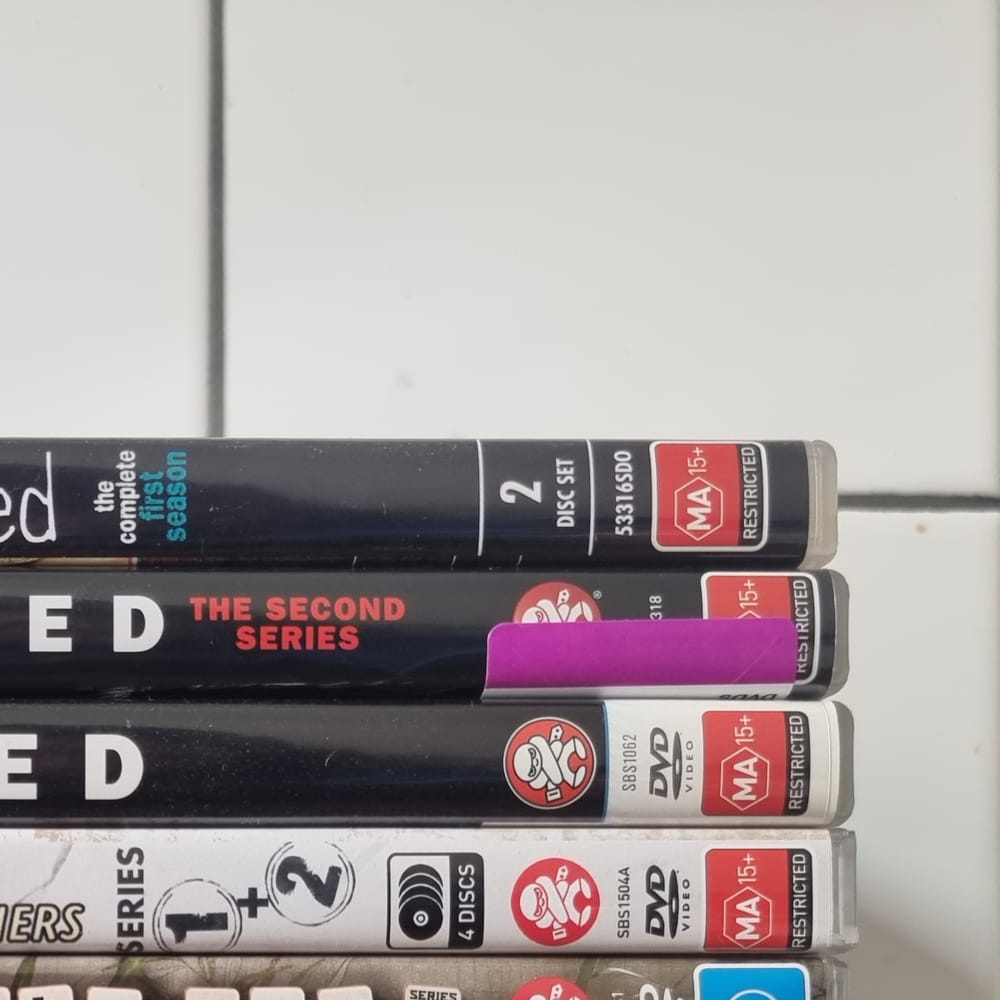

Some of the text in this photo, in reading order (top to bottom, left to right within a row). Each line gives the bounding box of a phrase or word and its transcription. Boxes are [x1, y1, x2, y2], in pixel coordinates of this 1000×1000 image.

[94, 480, 115, 513] the
[119, 450, 137, 545] complete
[140, 471, 164, 522] first
[166, 451, 188, 542] season
[500, 481, 542, 504] 2
[556, 457, 575, 528] DISC SET
[686, 446, 712, 531] MA 15+
[742, 446, 756, 541] RESTRICTED
[190, 597, 406, 622] THE SECOND
[738, 579, 759, 609] 15+
[236, 626, 360, 651] SERIES
[621, 733, 638, 793] SBS1062
[649, 727, 671, 800] DVD
[685, 740, 694, 793] VIDEO
[731, 714, 758, 802] MA 15+
[788, 714, 803, 811] RESTRICTED
[115, 846, 145, 953] SERIES
[457, 863, 476, 941] 4 DISCS
[617, 866, 631, 940] SBS1504A
[645, 864, 667, 939] DVD
[681, 878, 691, 932] VIDEO
[734, 852, 761, 940] MA 15+
[791, 853, 807, 949] RESTRICTED
